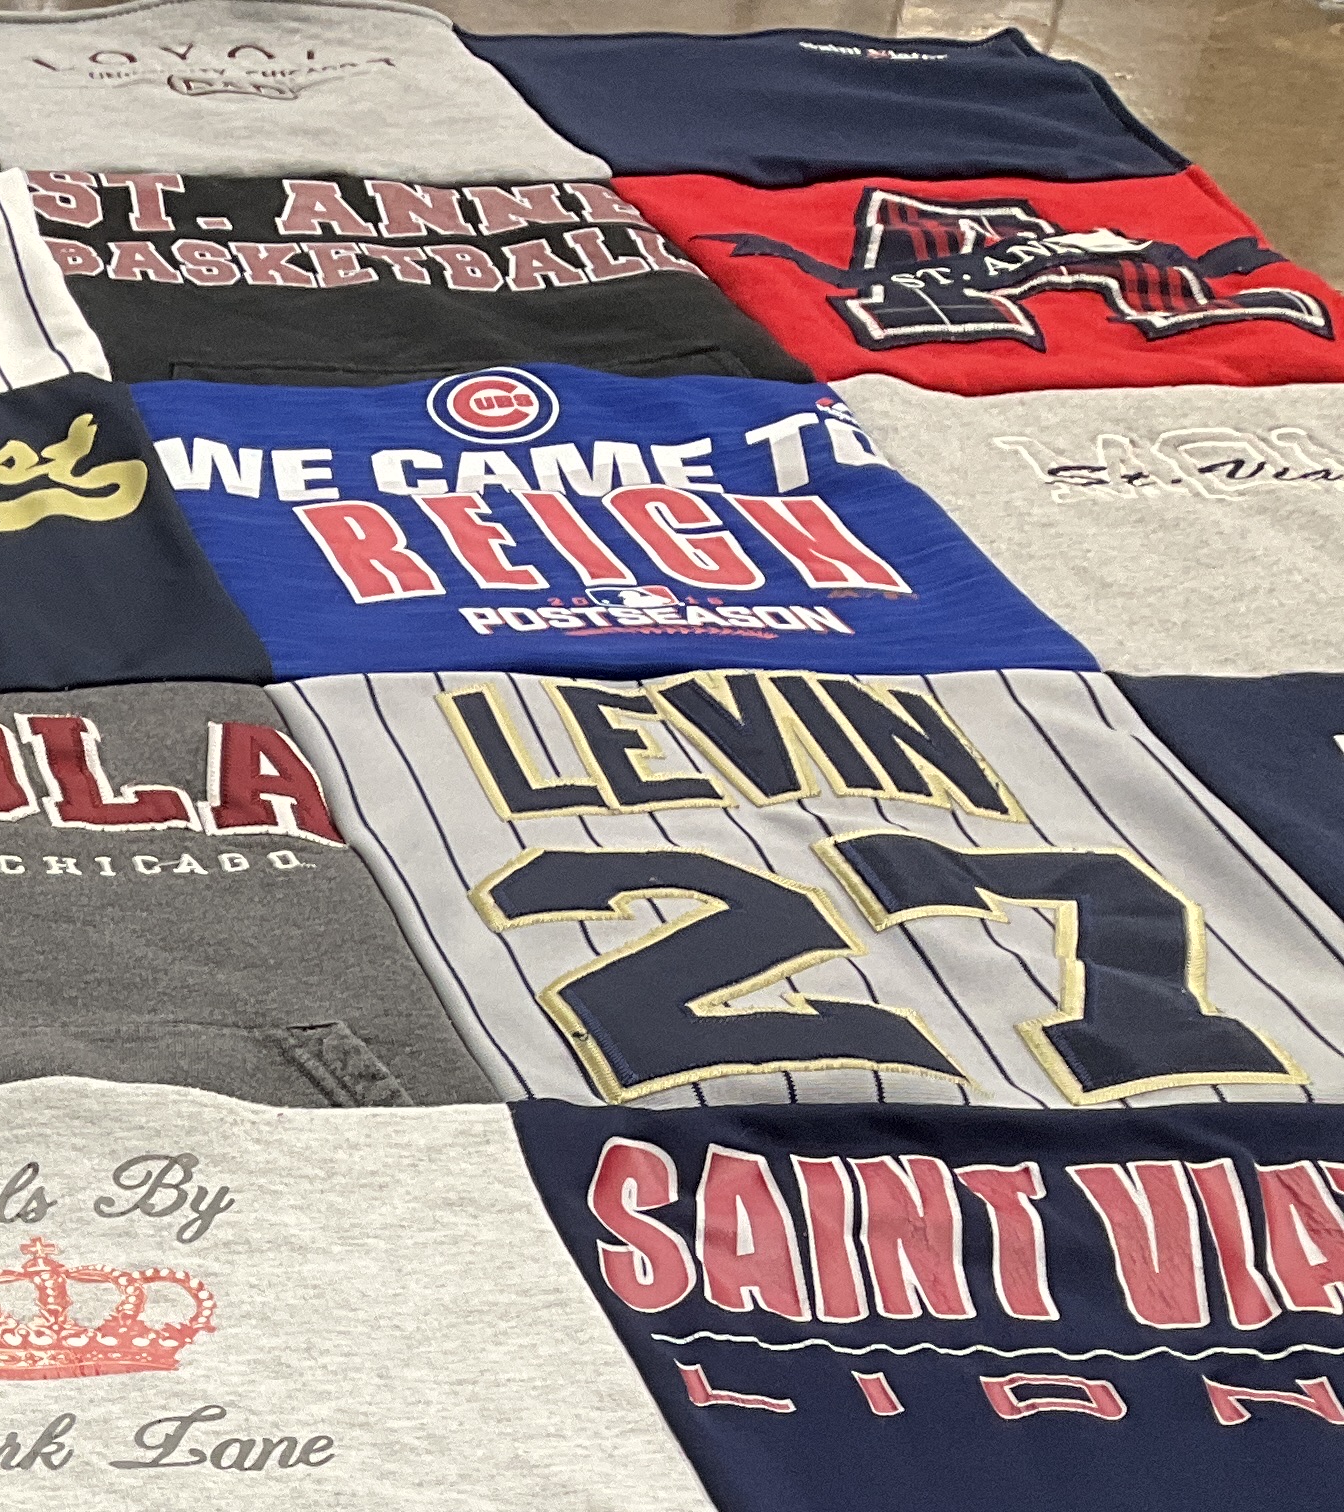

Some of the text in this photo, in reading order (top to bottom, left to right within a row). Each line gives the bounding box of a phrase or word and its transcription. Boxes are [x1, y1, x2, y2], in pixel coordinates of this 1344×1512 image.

[24, 168, 233, 233] ST.
[152, 437, 340, 502] WE
[371, 438, 724, 497] CAME
[293, 485, 914, 605] REIGN
[458, 605, 856, 635] POSTSEASON
[434, 668, 1030, 824] LEVIN
[466, 828, 1313, 1106] 27
[93, 1152, 235, 1244] By
[587, 1135, 1344, 1331] SAINT VIA
[111, 1404, 337, 1472] Lane
